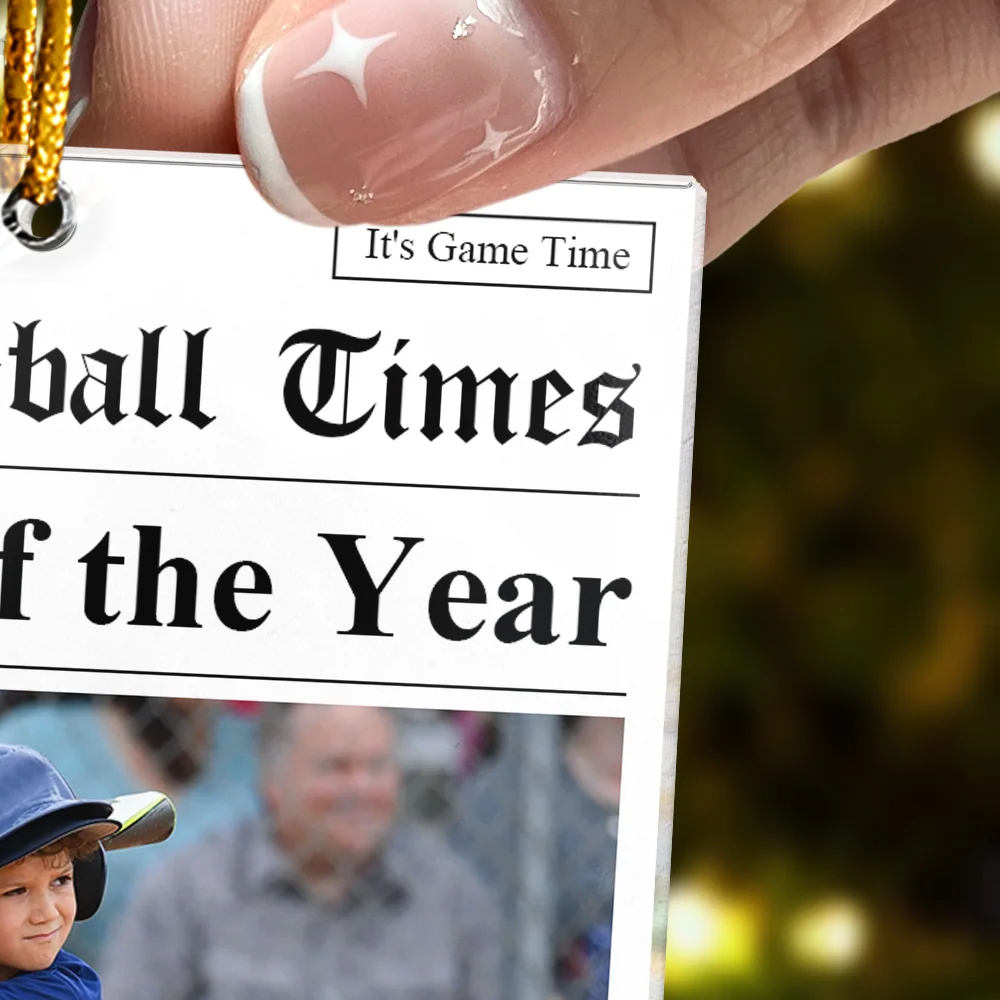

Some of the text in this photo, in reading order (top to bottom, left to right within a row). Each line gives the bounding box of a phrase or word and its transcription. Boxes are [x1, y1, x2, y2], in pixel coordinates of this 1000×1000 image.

[364, 228, 631, 270] It's Game Time
[278, 328, 641, 449] Times
[77, 524, 273, 632] the
[317, 532, 632, 647] Year
